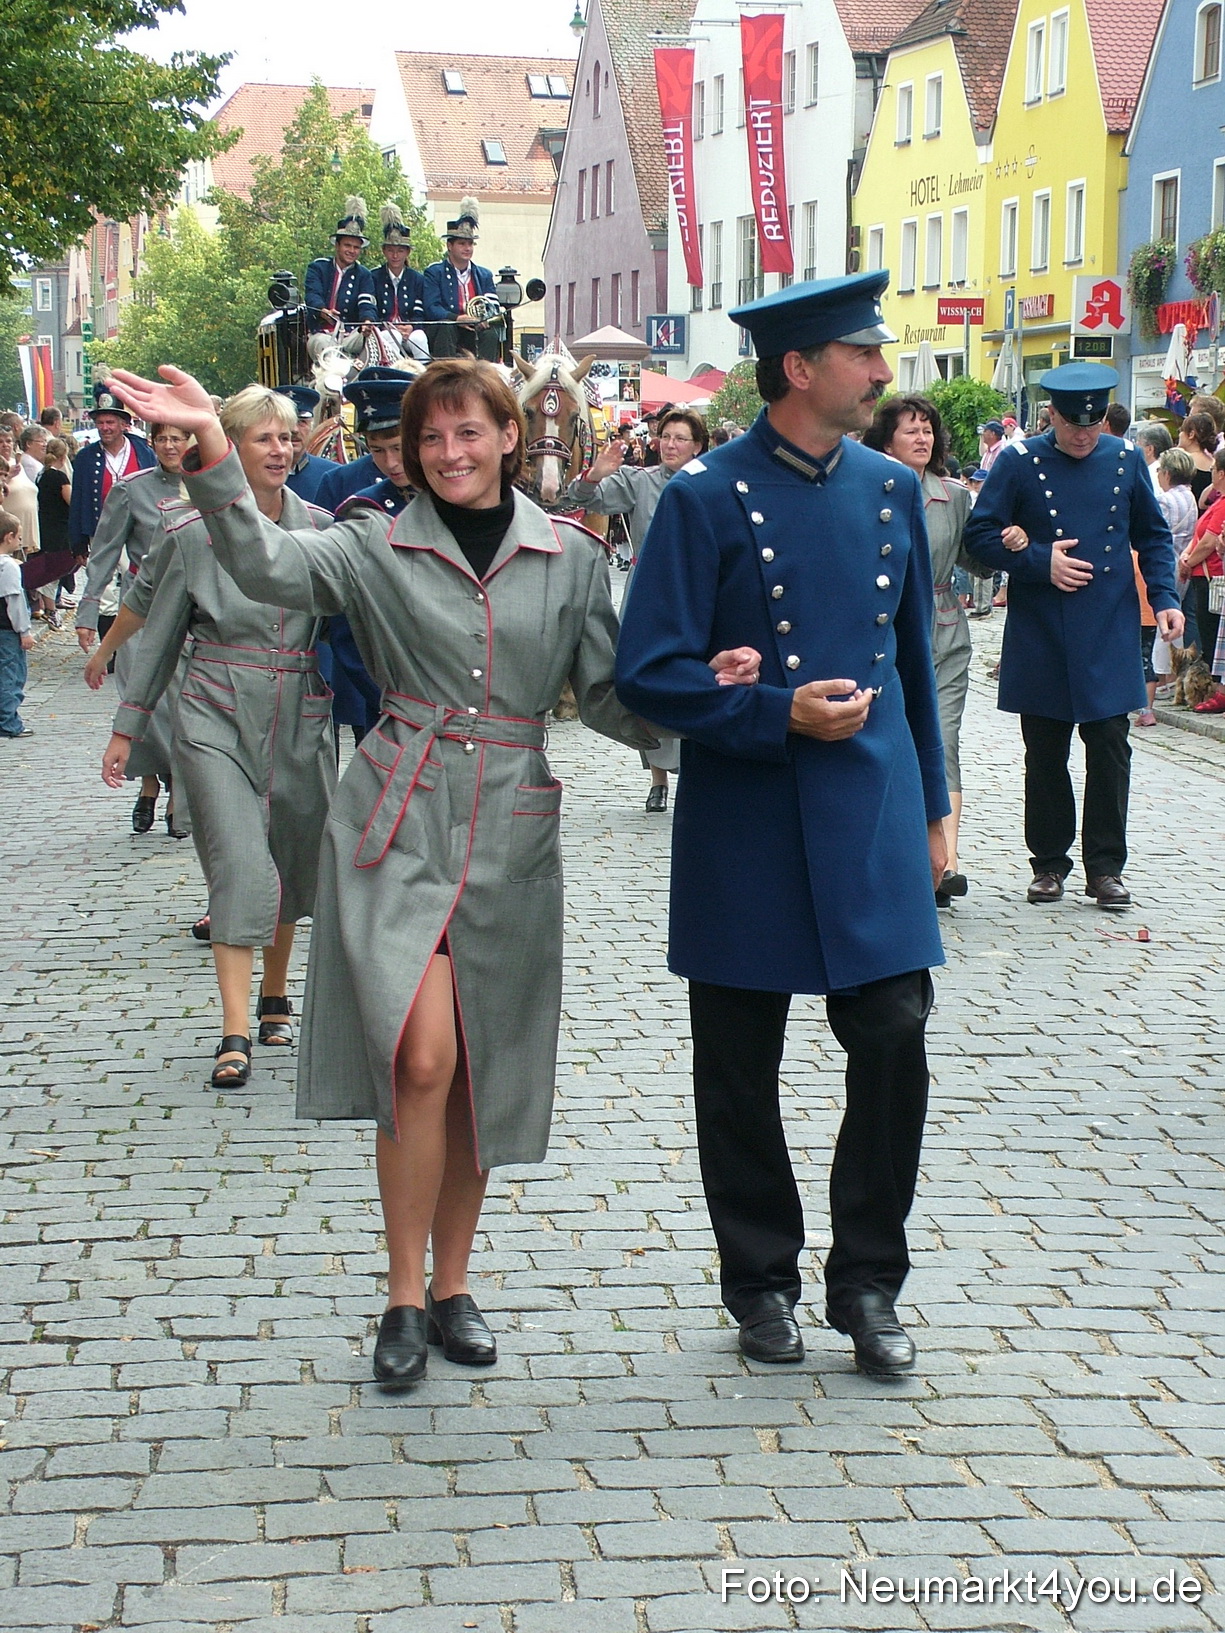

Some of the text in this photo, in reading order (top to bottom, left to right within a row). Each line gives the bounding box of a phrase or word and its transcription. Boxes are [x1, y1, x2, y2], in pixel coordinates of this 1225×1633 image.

[749, 94, 784, 242] REDUZIERT
[910, 169, 984, 207] HOTEL Lehmeier
[1006, 299, 1013, 322] P
[904, 324, 947, 346] Restaurant
[84, 323, 93, 406] APTHEKE
